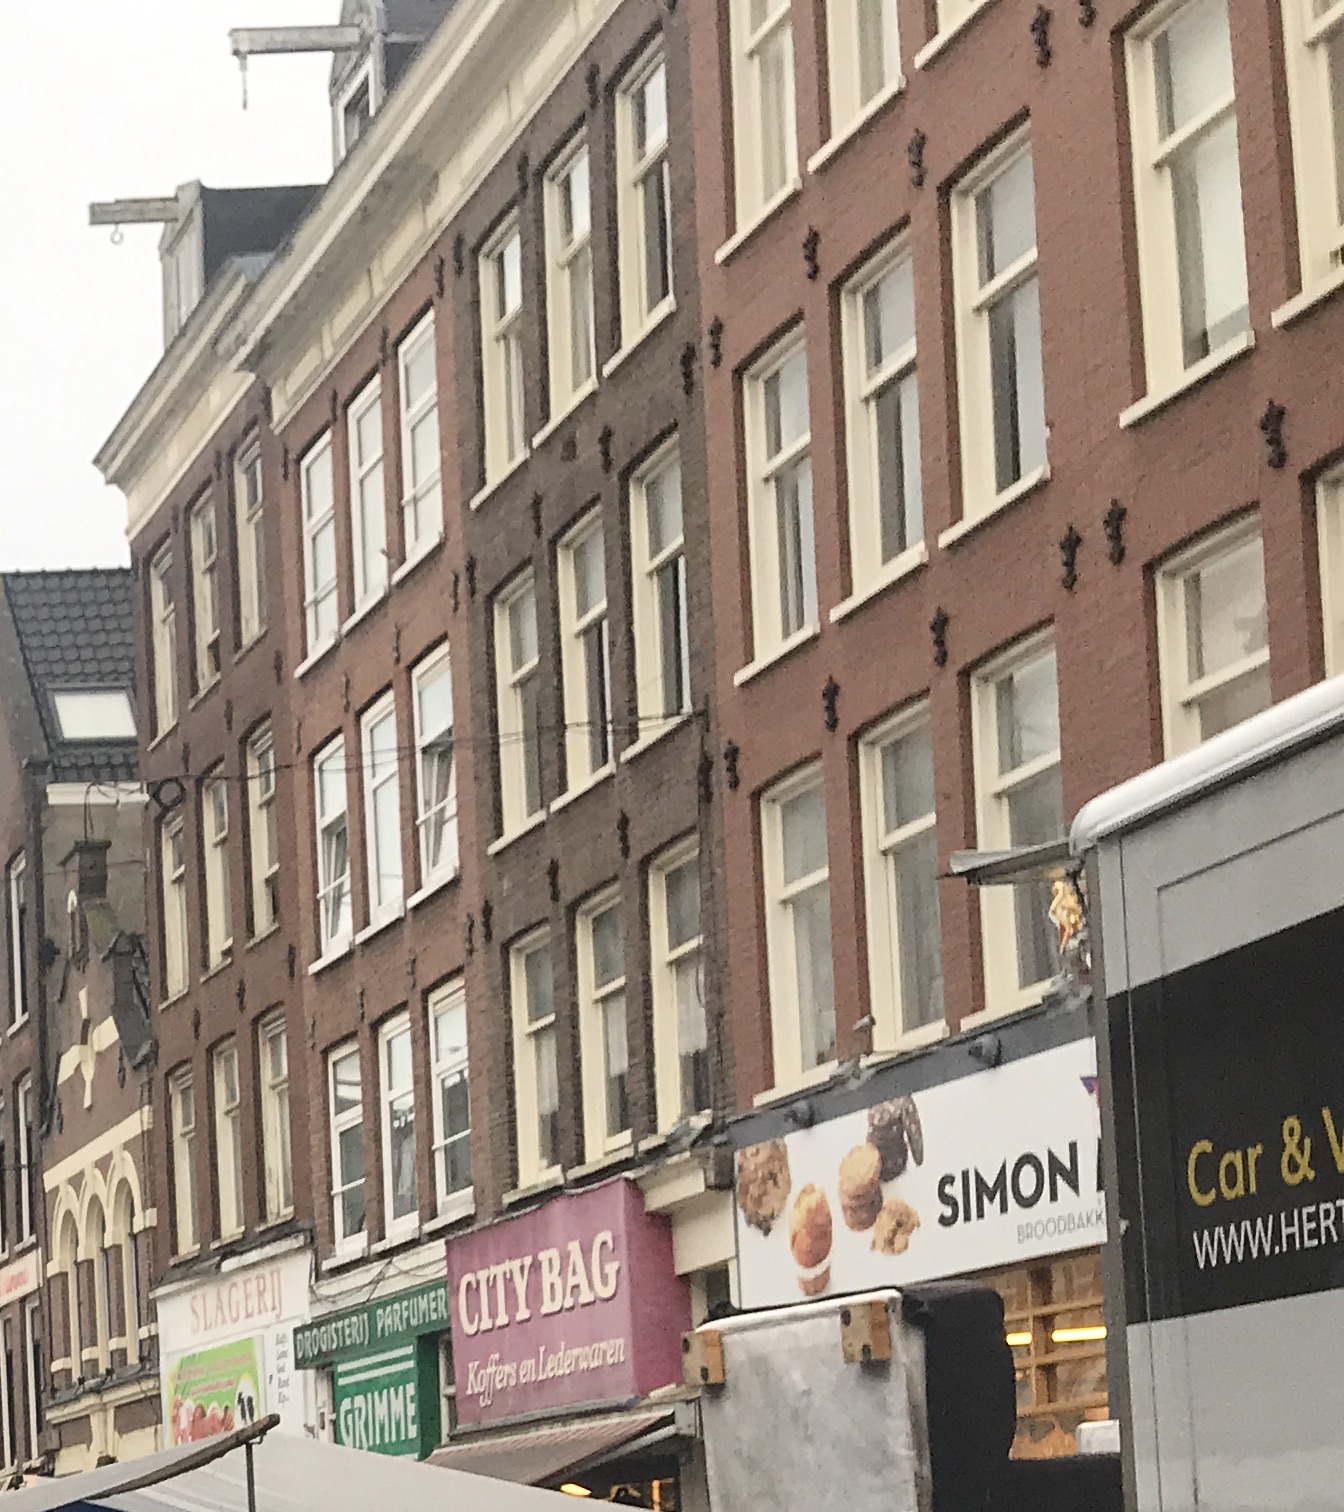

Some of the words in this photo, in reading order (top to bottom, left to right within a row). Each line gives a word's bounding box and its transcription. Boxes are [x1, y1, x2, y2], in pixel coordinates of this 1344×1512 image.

[937, 1138, 1080, 1229] SIMON
[1187, 1139, 1263, 1207] Car
[1281, 1115, 1316, 1185] &
[190, 1267, 283, 1335] SLAGERIJ
[376, 1287, 450, 1338] PARFUMER
[458, 1255, 533, 1337] CITY
[538, 1230, 621, 1318] BAG
[296, 1311, 370, 1360] DROGISTERIJ
[466, 1353, 518, 1407] Koffers
[519, 1358, 537, 1384] en
[537, 1338, 626, 1382] Lederwaren
[340, 1382, 418, 1451] GRIMME
